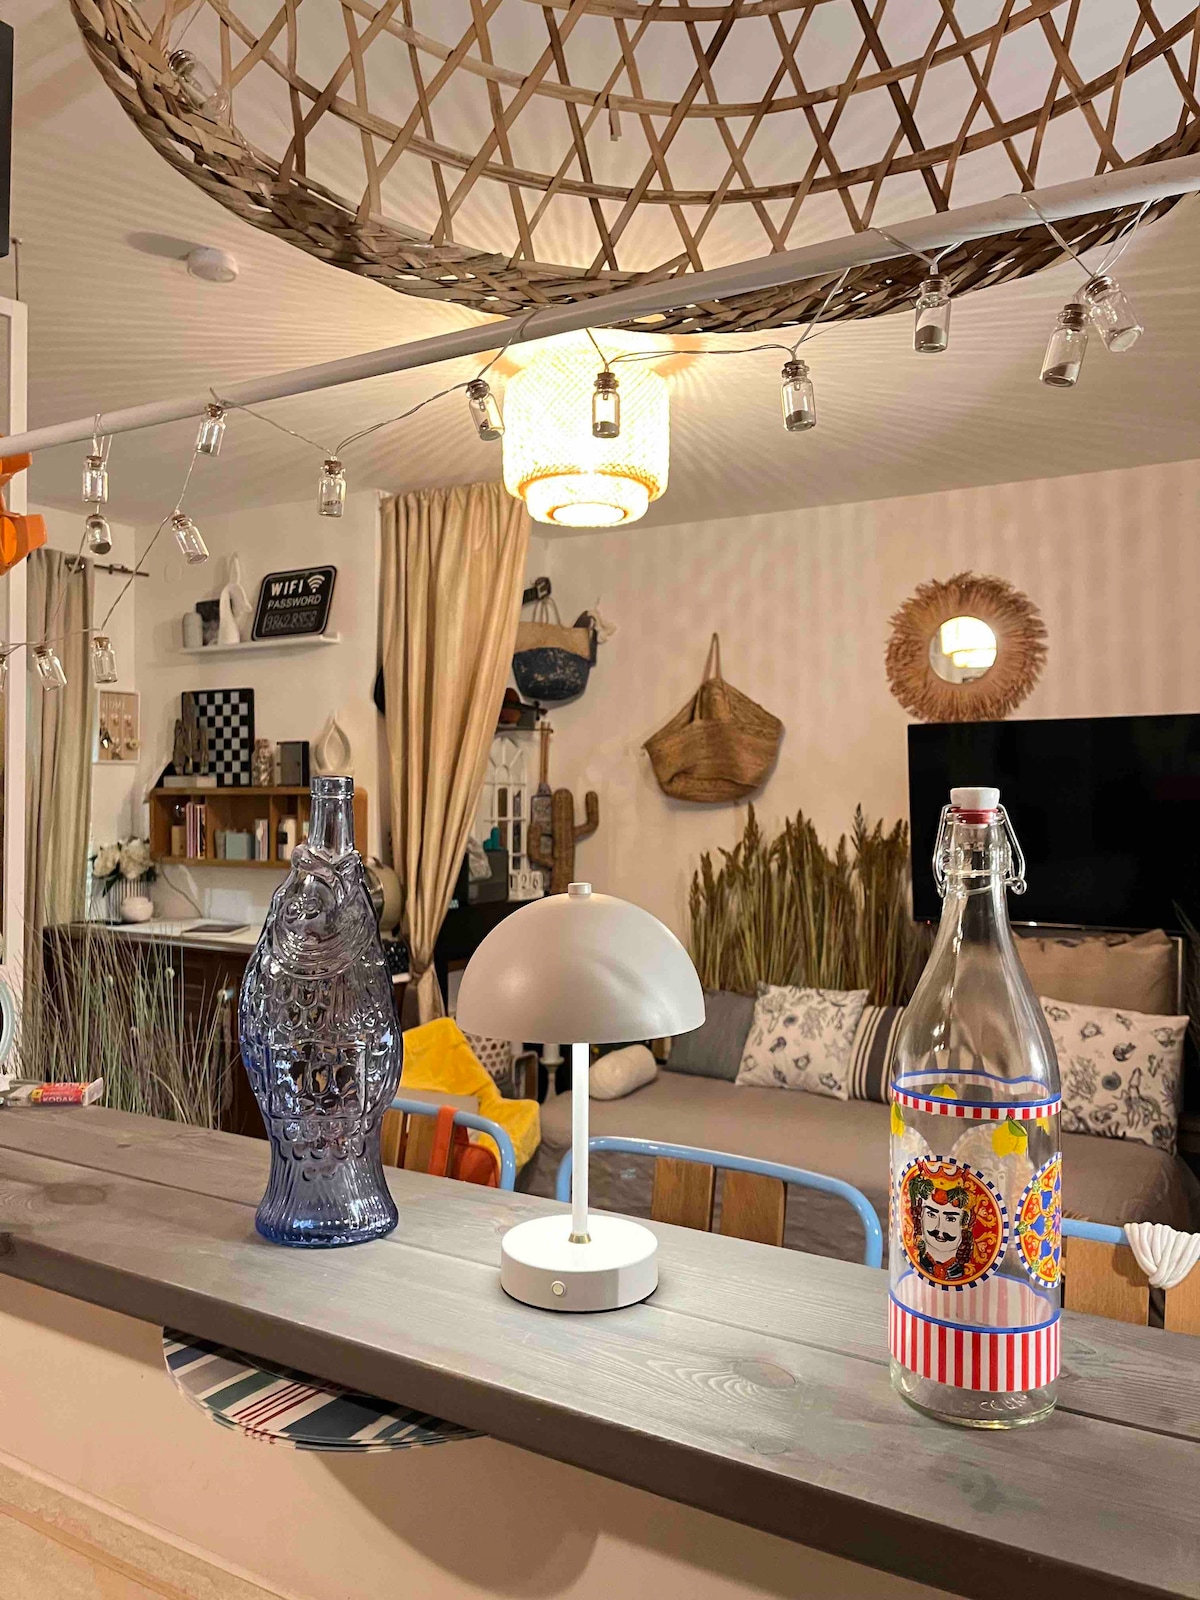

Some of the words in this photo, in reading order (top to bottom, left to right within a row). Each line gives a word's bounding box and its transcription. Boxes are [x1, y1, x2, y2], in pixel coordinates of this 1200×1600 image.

[271, 579, 304, 597] WIFI
[267, 594, 322, 610] PASSWORD
[42, 1095, 74, 1103] KODAK
